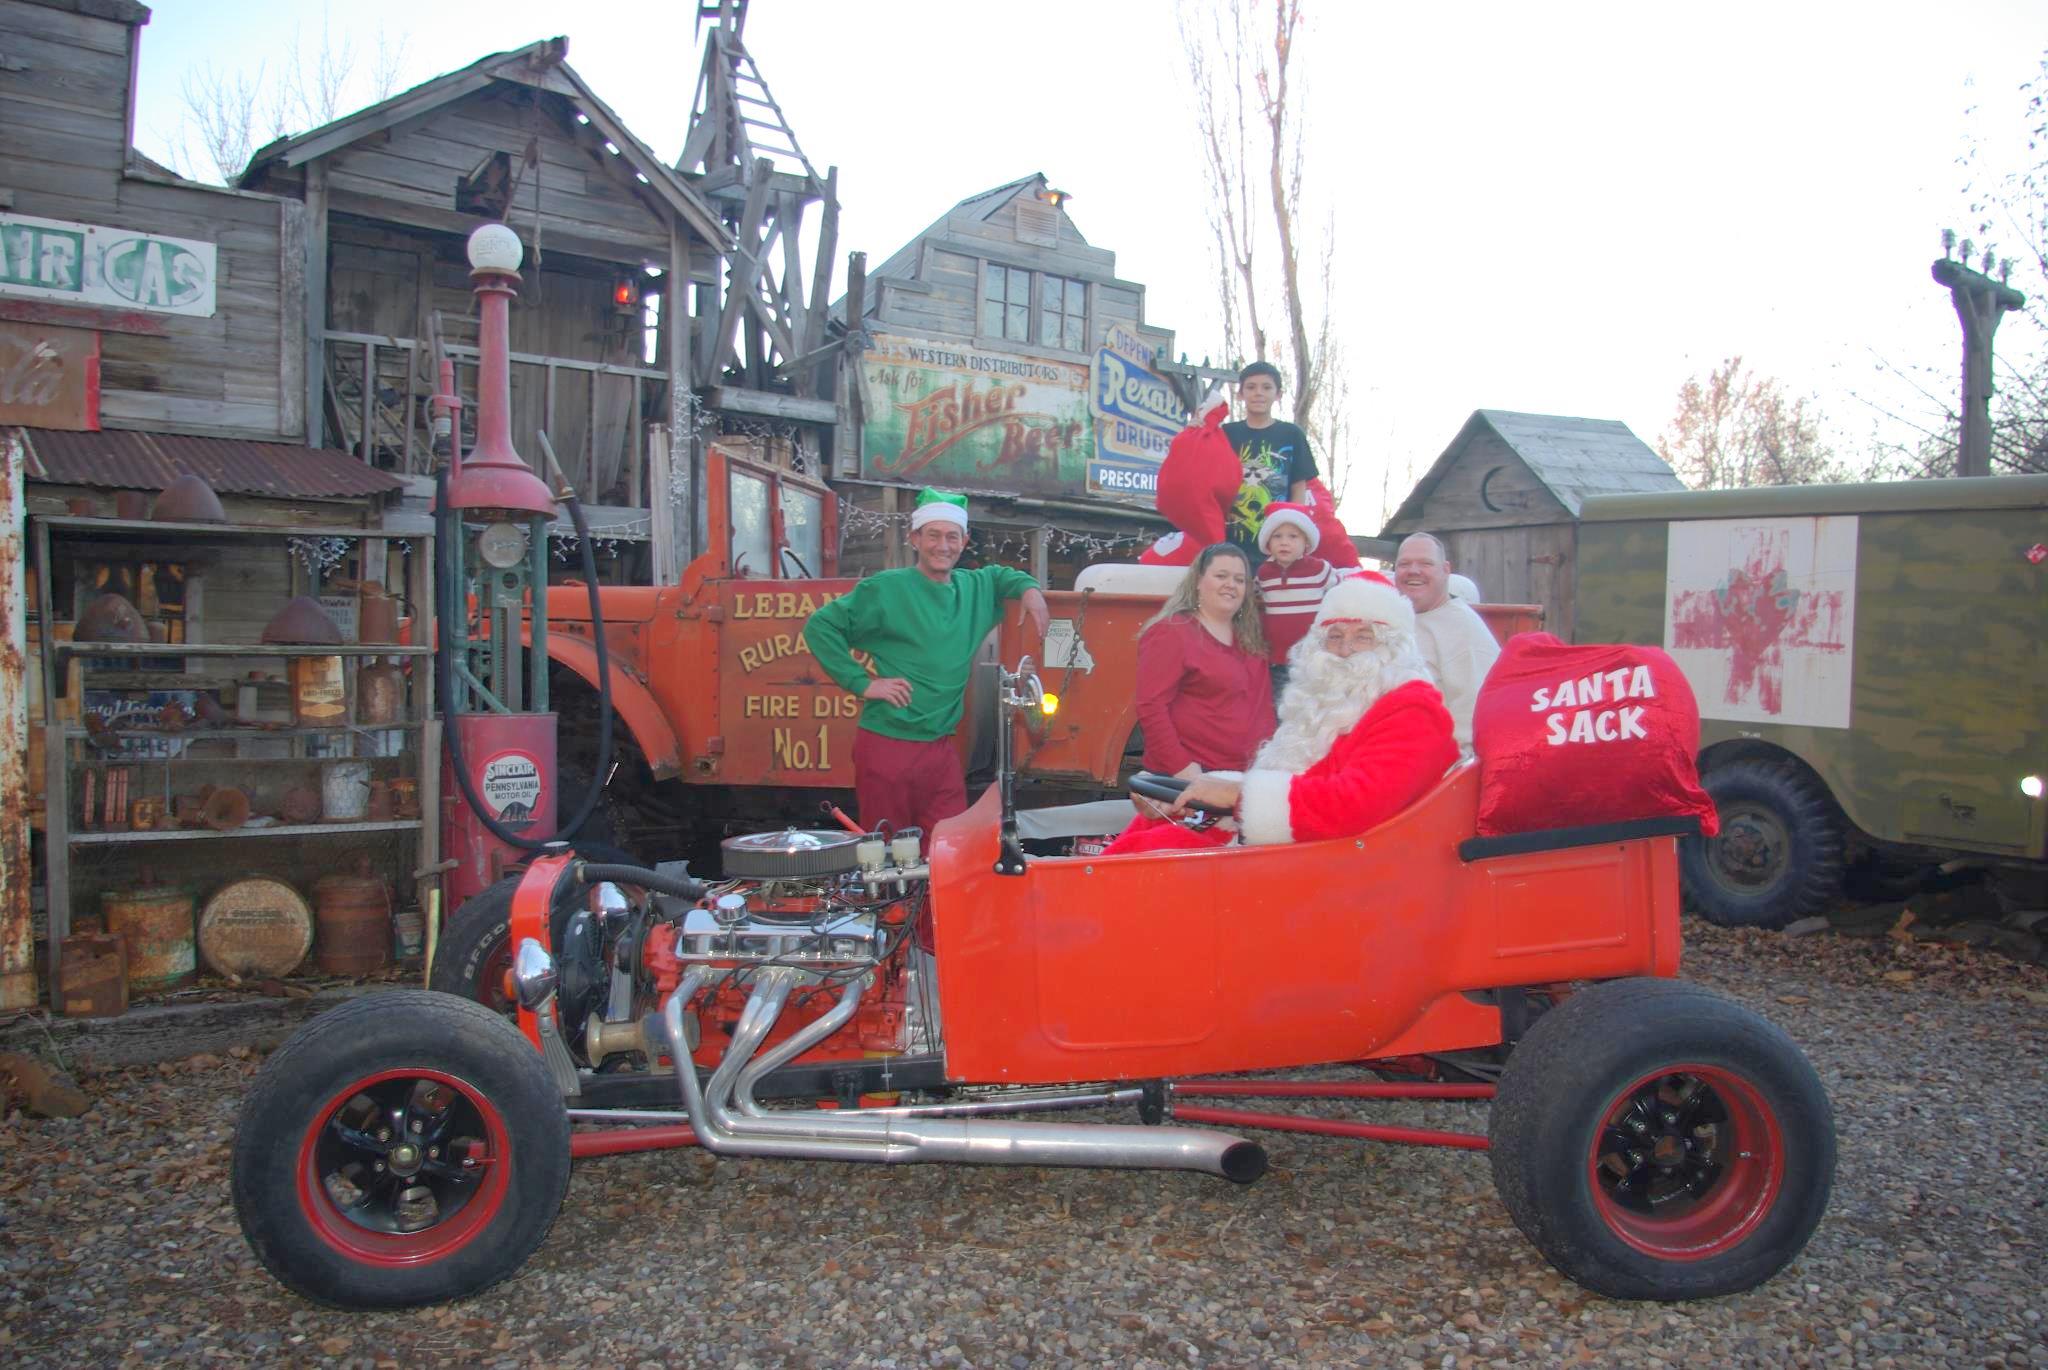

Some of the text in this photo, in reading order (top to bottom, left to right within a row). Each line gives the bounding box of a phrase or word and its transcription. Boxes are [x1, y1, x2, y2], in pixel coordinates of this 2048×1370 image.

[909, 347, 1059, 381] WESTERN DISTRIBUTORS
[1116, 330, 1151, 363] DEPEN
[869, 368, 926, 393] Ask for
[1104, 353, 1188, 426] Rexall
[874, 380, 1026, 472] Fisher
[976, 418, 1083, 471] Beer
[739, 632, 811, 672] RURA
[746, 695, 862, 718] FIRE DIS
[1530, 665, 1655, 712] SANTA
[1546, 705, 1648, 745] SACK
[485, 780, 538, 792] PENNSYLVANIA
[486, 762, 536, 781] SINCLAIR
[464, 920, 512, 979] BFGO
